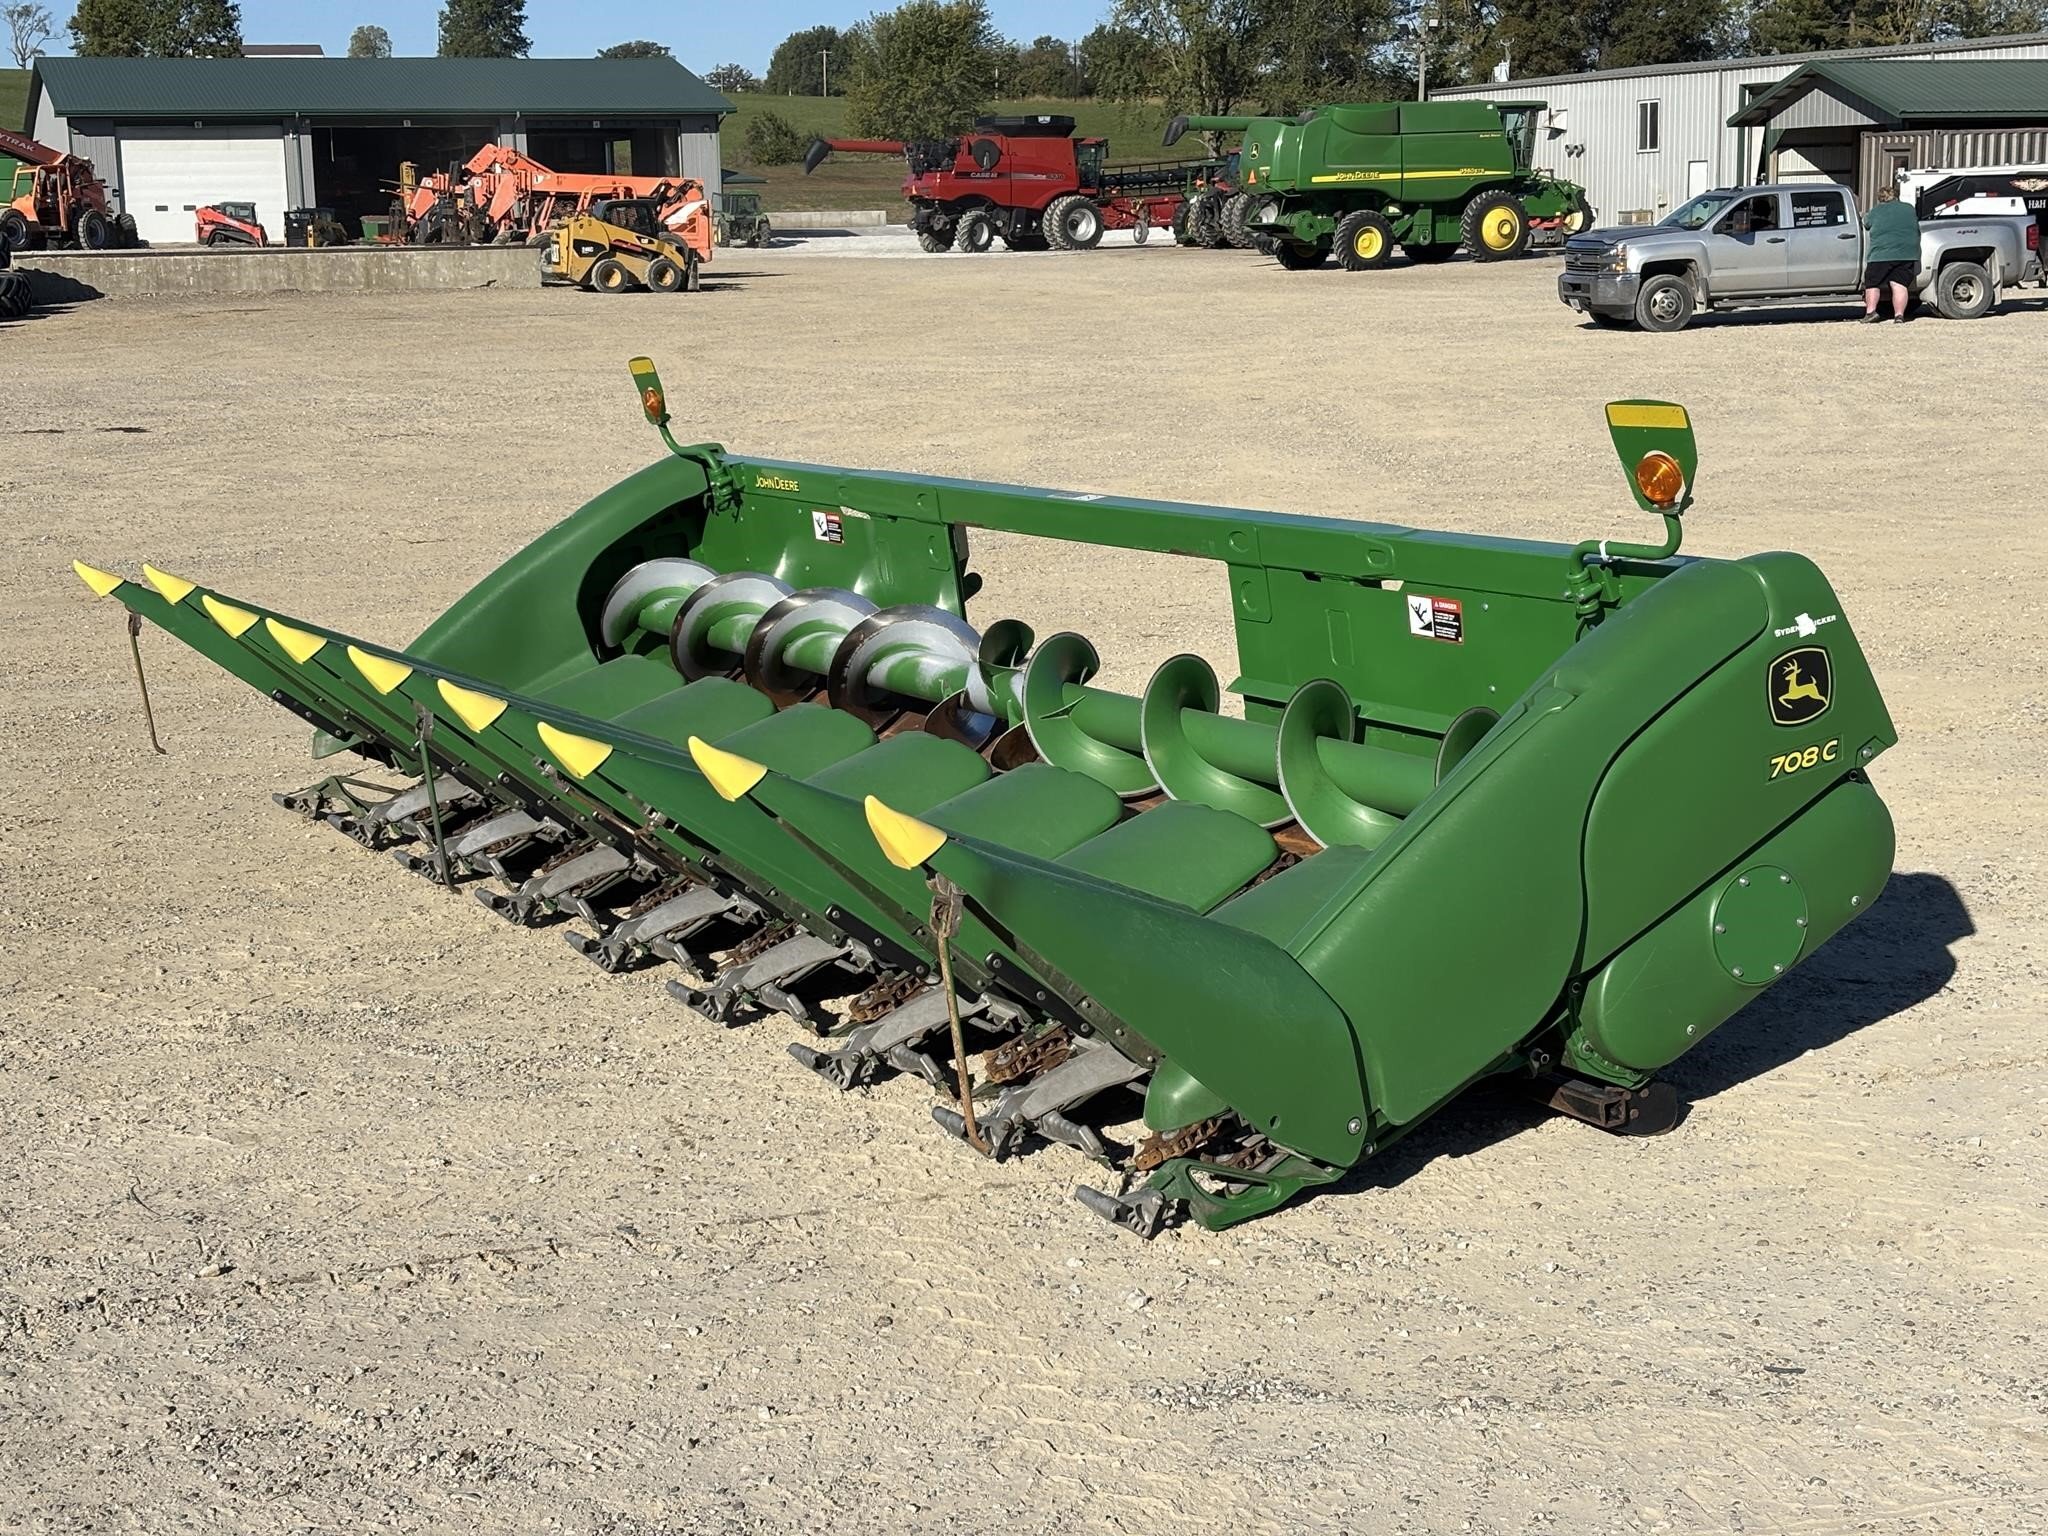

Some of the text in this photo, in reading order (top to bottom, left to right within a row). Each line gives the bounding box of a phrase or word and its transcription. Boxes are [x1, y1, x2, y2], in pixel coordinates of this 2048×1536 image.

[1355, 171, 1380, 179] DEERE
[2028, 199, 2047, 209] H&H
[755, 474, 800, 491] JOHN DEERE
[1768, 738, 1840, 780] 708 C
